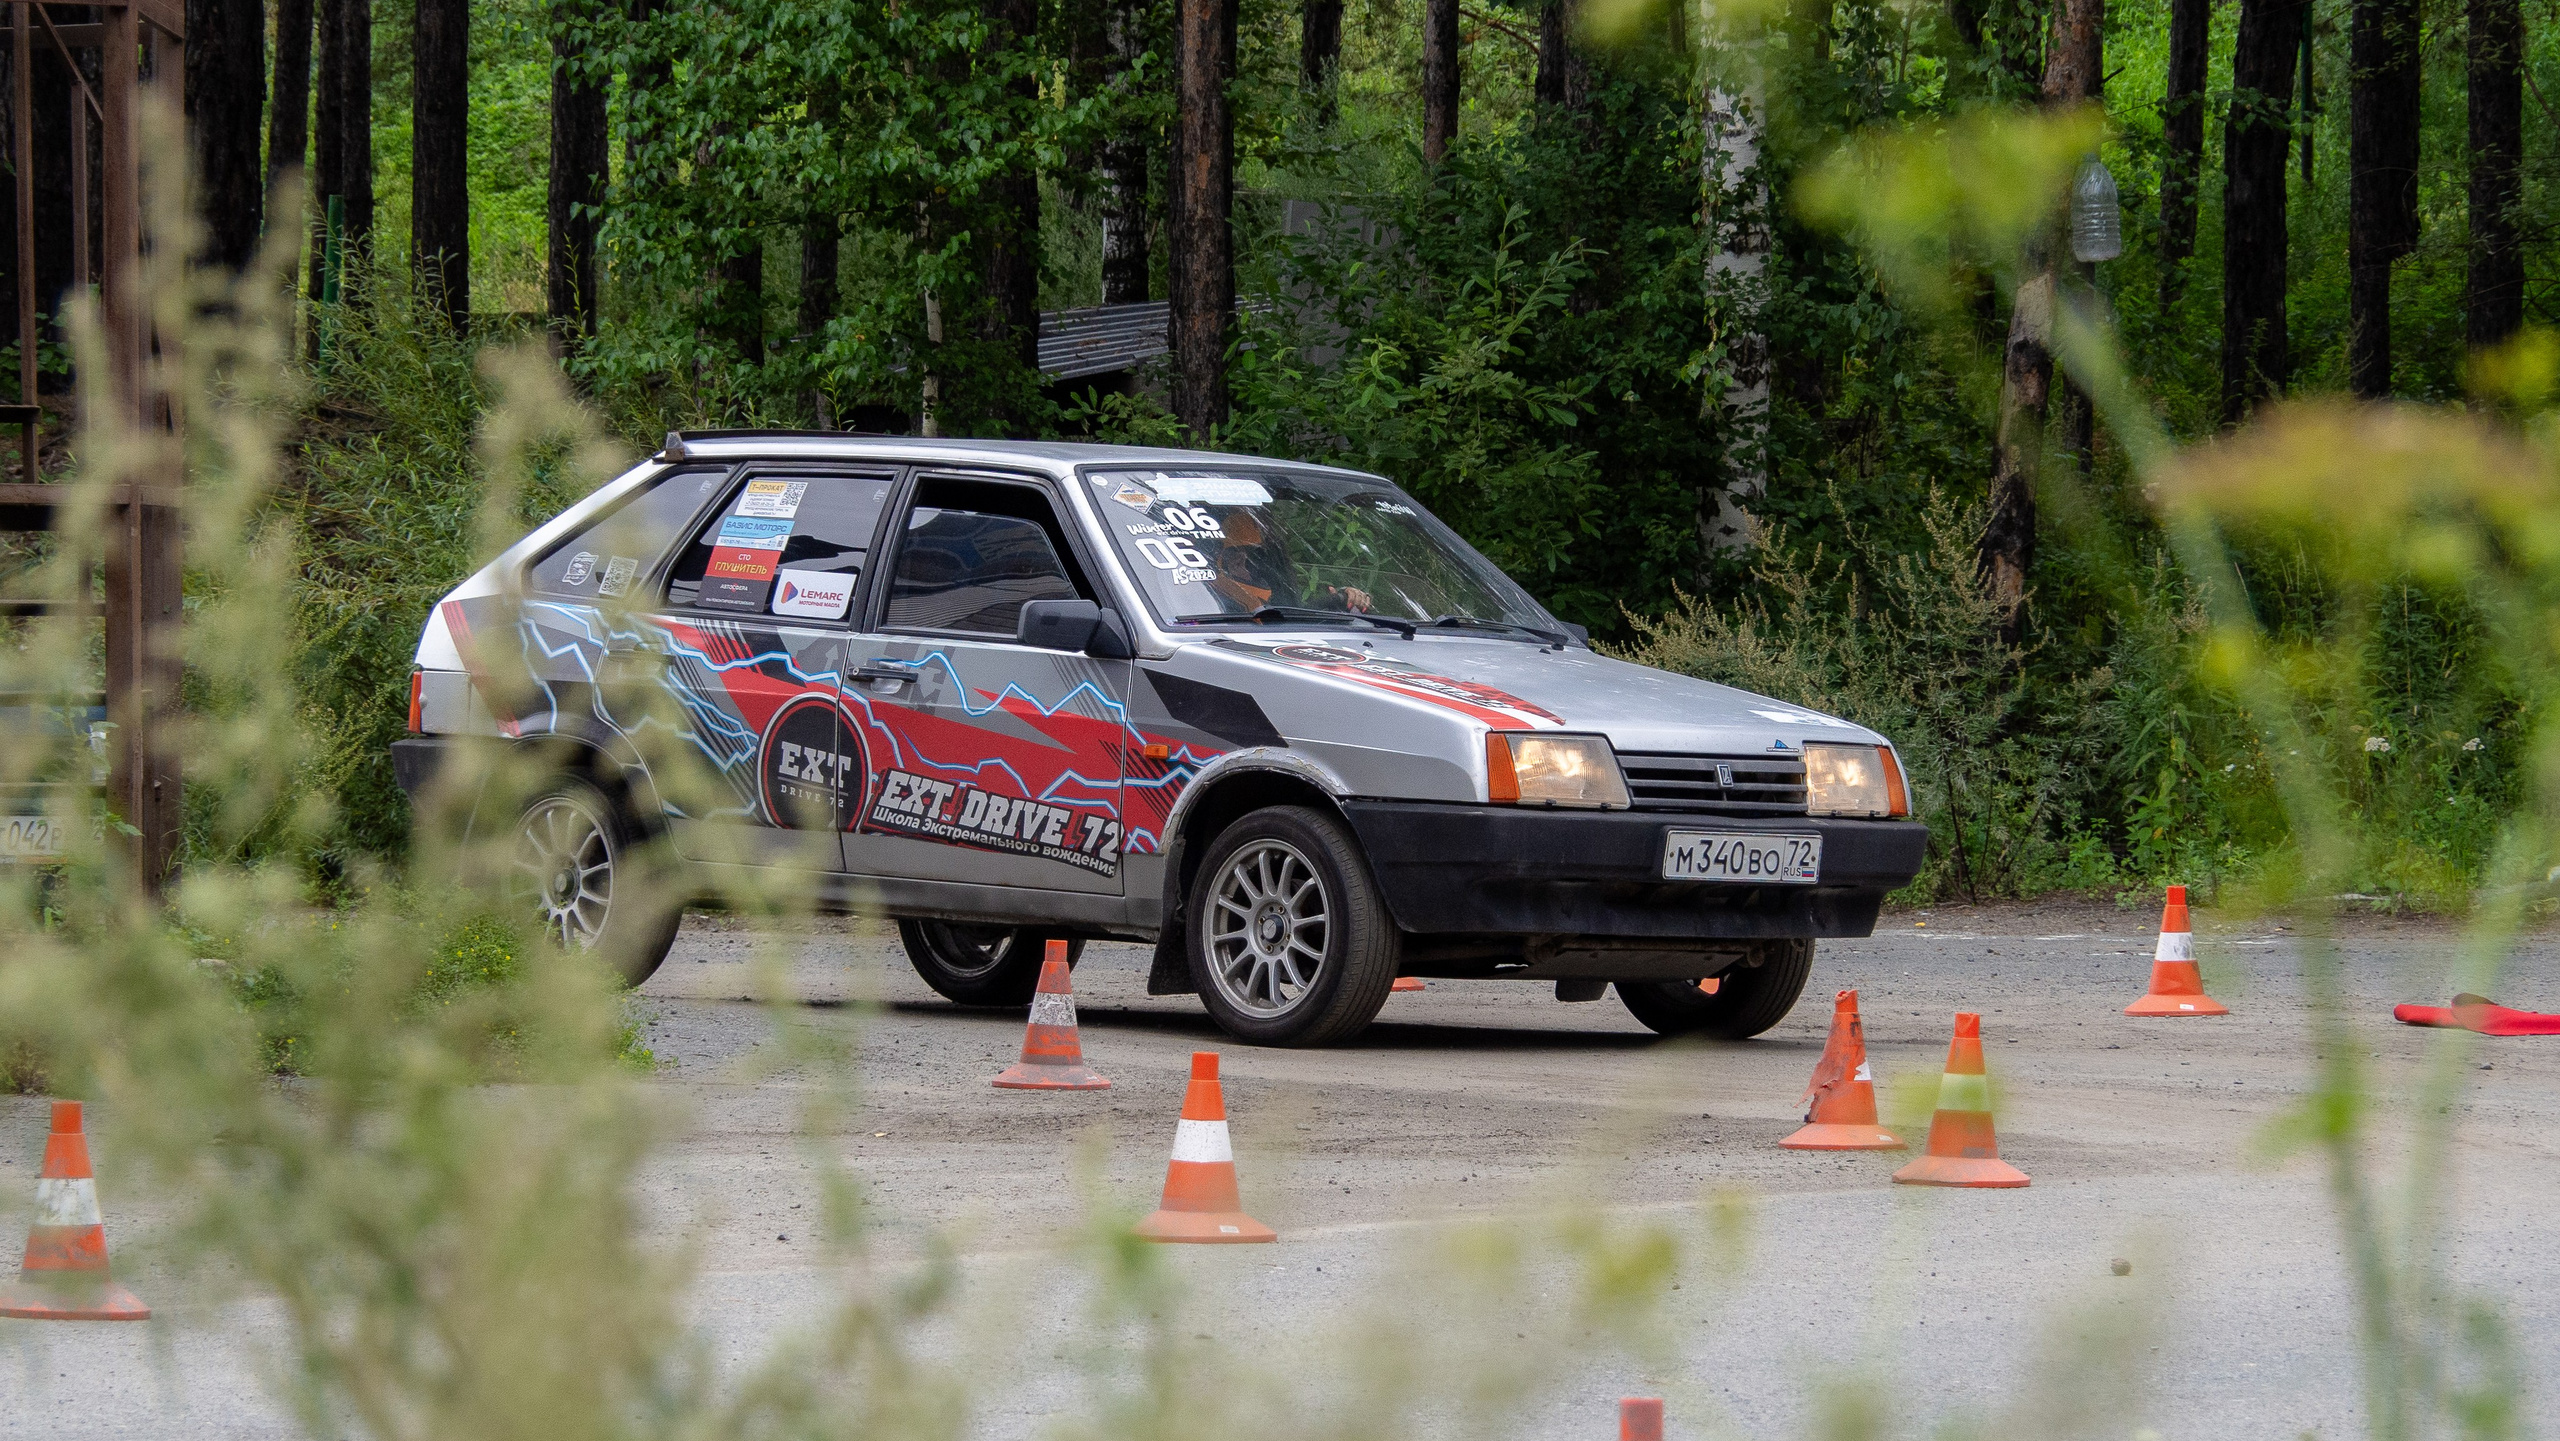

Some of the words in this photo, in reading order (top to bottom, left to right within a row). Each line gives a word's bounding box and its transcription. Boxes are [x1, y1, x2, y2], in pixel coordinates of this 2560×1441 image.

[1163, 507, 1220, 531] 06
[725, 521, 753, 530] БАЗИС
[754, 523, 788, 532] МОТОРС
[1126, 522, 1174, 536] Winter
[1190, 530, 1226, 539] TMN
[738, 553, 752, 561] СТО
[1134, 537, 1208, 570] 06
[714, 561, 768, 575] ГЛУШИТЕЛЬ
[1189, 570, 1214, 581] 2024
[720, 583, 748, 591] АВТОСФЕРА
[800, 588, 844, 601] LEMARC
[779, 741, 852, 788] EXT
[781, 784, 821, 802] DRIVE
[829, 796, 844, 808] 72
[959, 789, 1071, 846] DRIVE
[1082, 815, 1125, 862] 72
[872, 805, 921, 829] Школа
[921, 818, 1040, 853] Экстремального
[1042, 846, 1115, 876] вождения
[1788, 840, 1811, 866] 72
[1783, 866, 1801, 877] RUS
